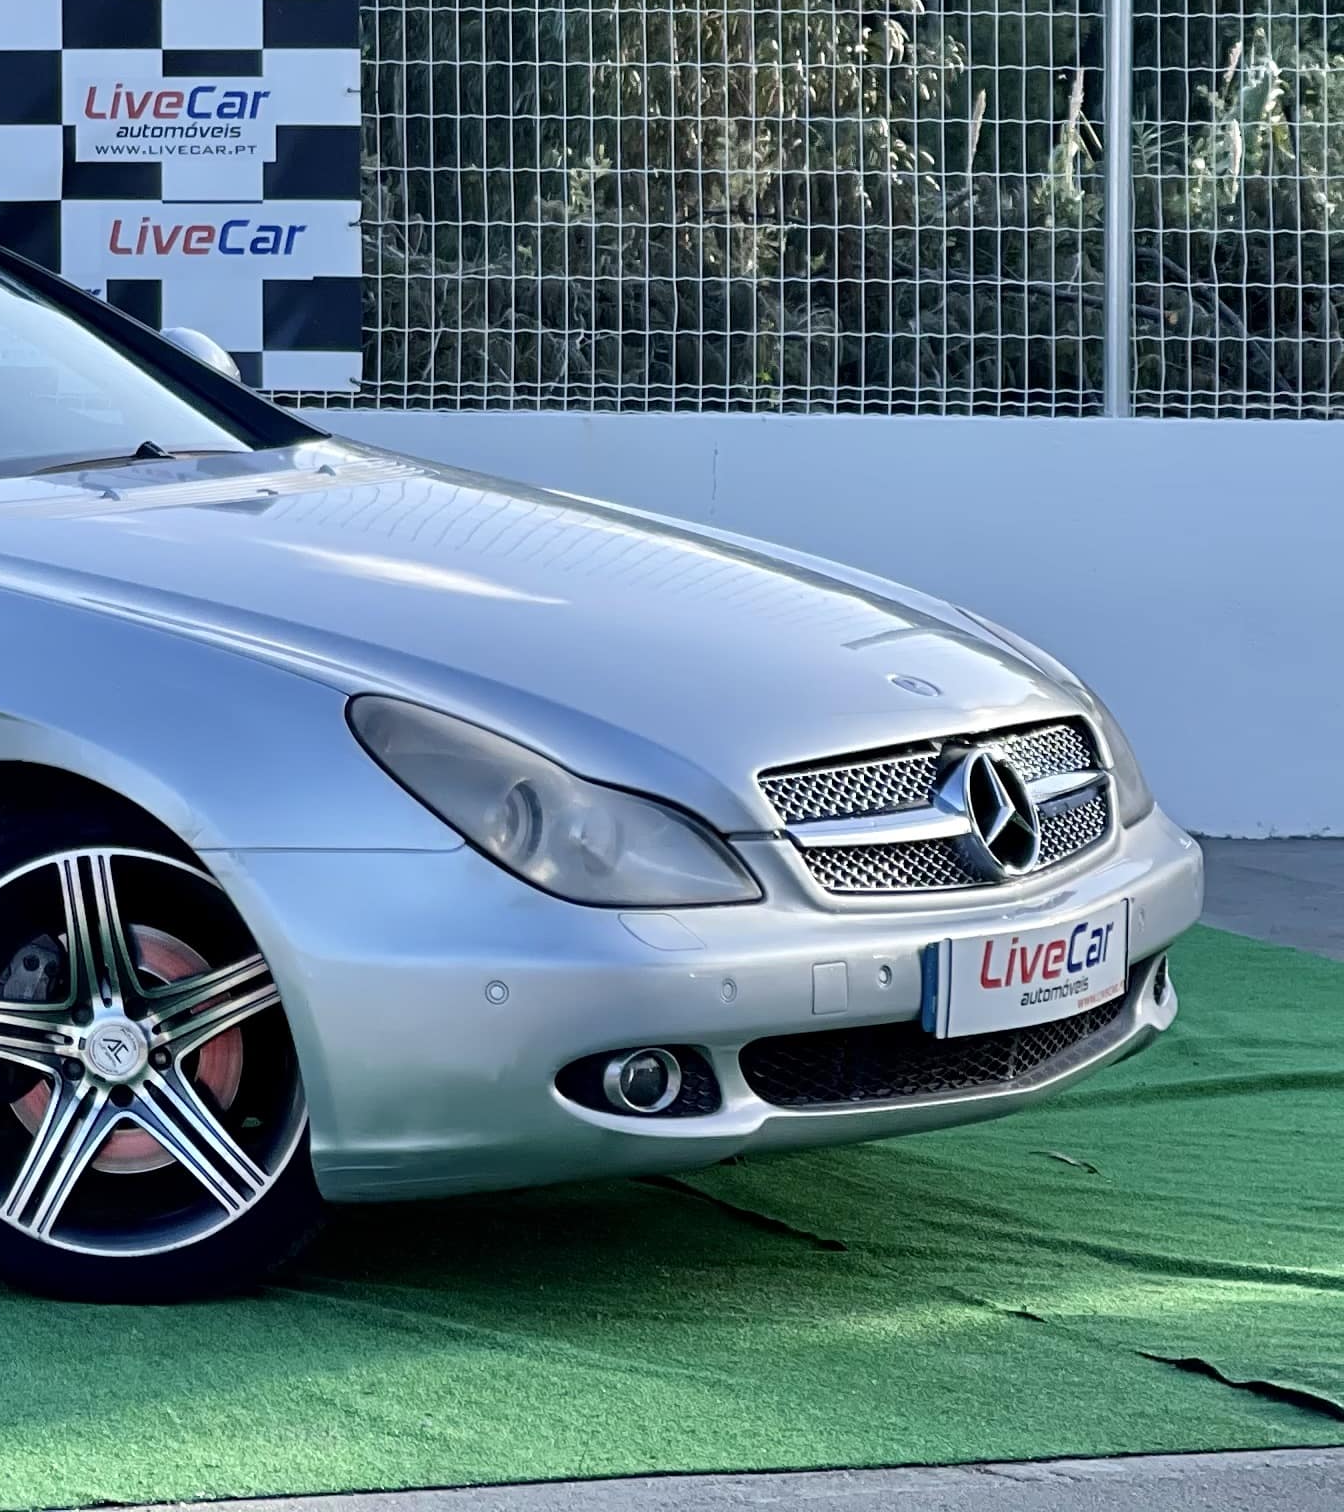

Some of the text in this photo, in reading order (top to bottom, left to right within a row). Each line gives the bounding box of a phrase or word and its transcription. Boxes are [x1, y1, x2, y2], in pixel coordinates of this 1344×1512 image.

[84, 83, 269, 119] LiveCar
[116, 122, 241, 139] automóveis
[95, 145, 257, 154] WWW.LIVECAR.PT
[108, 217, 306, 255] LiveCar
[980, 921, 1114, 989] LiveCar
